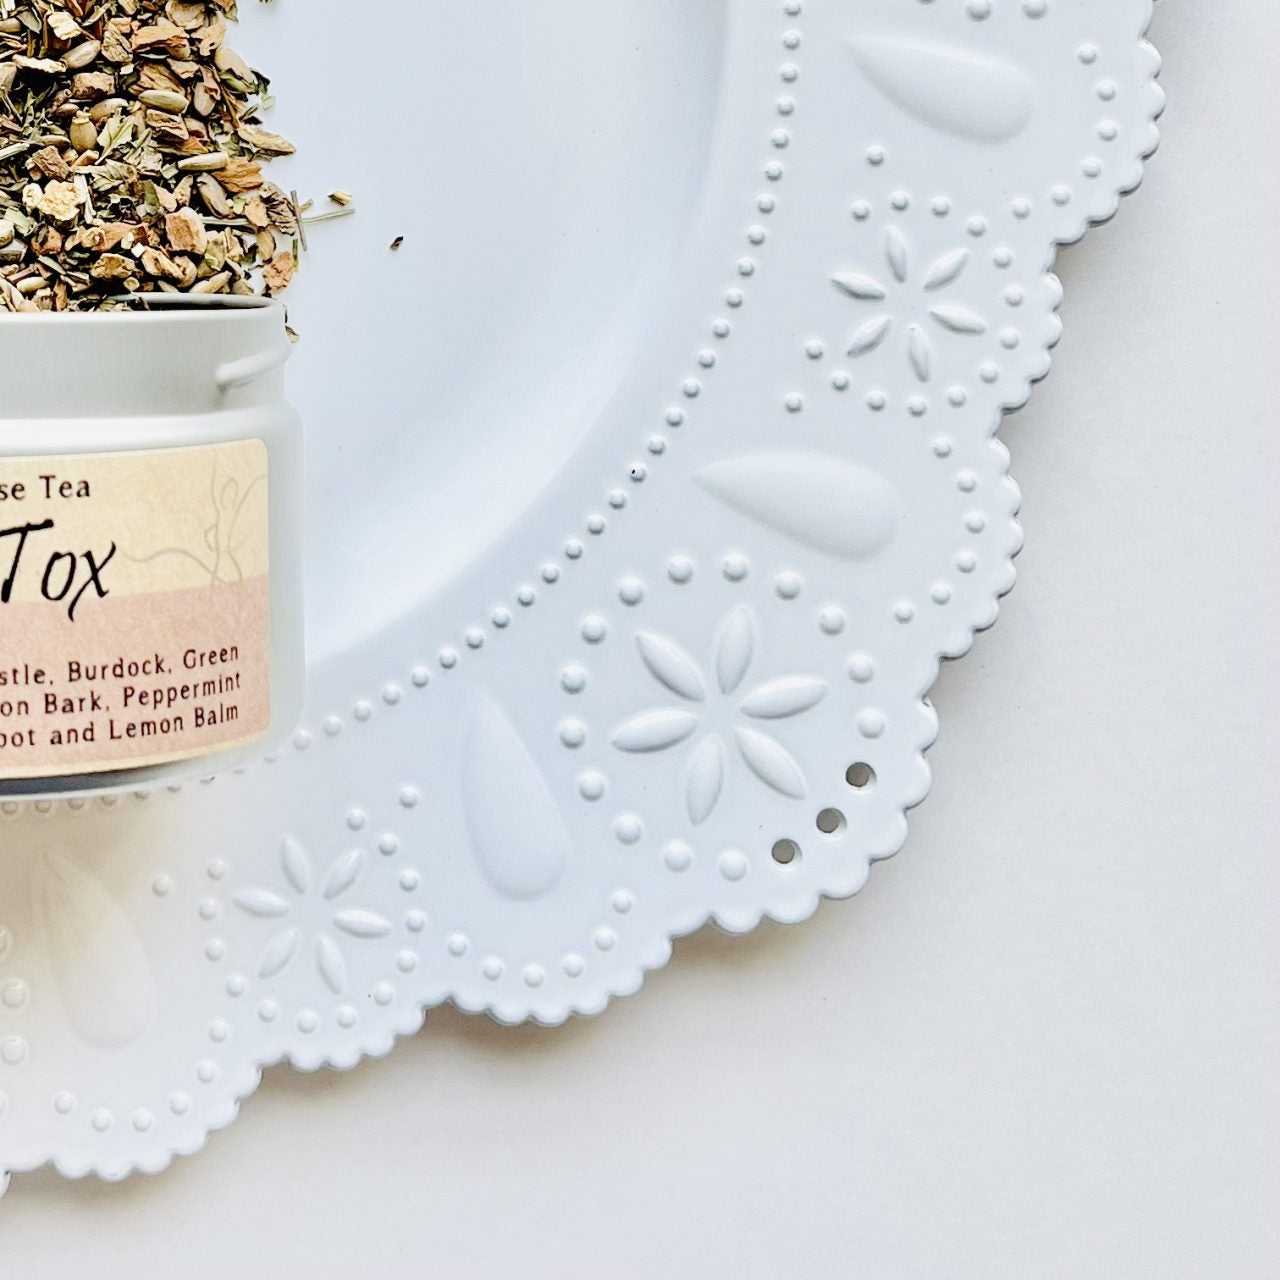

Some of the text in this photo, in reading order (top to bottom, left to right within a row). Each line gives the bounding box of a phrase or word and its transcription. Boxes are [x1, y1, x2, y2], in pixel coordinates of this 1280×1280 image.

[39, 474, 91, 499] Tea
[183, 645, 239, 669] Green
[123, 671, 242, 709] Peppermint
[49, 721, 95, 746] and
[109, 715, 184, 740] Lemon
[195, 703, 239, 728] Balm
